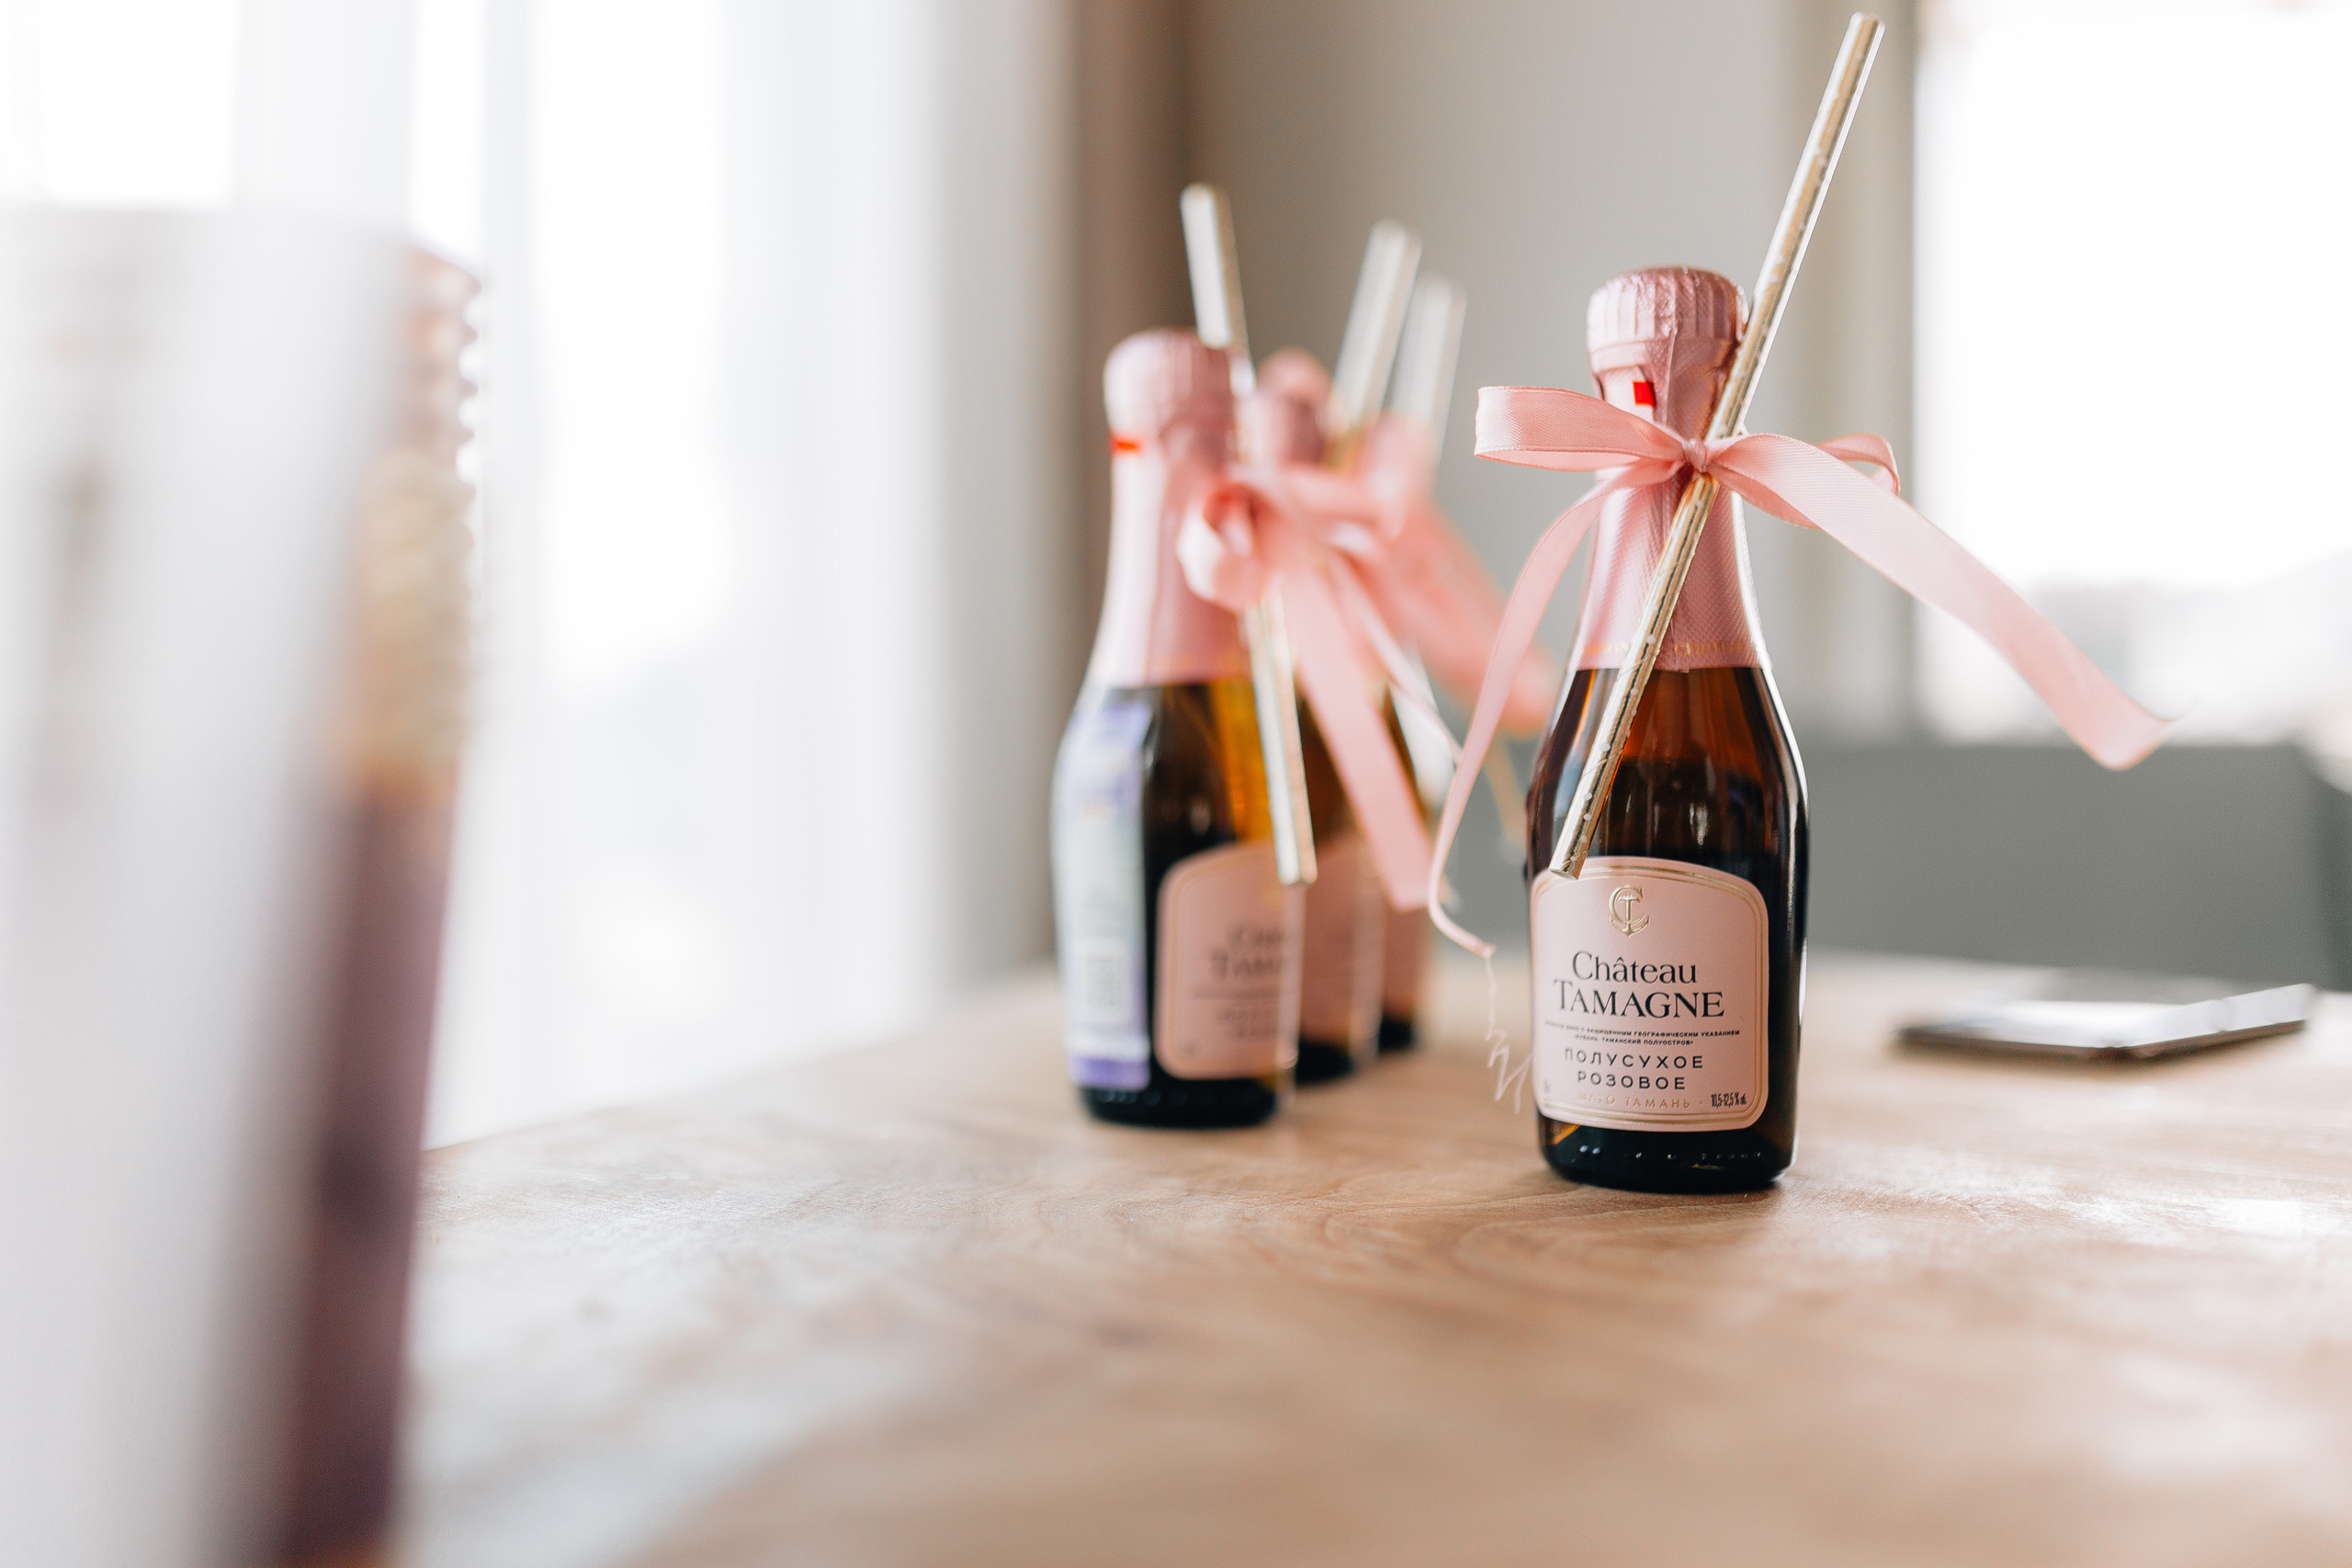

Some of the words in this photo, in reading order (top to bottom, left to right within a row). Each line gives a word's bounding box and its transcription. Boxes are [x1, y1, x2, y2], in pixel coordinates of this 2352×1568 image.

[1572, 951, 1697, 984] Château
[1554, 978, 1725, 1019] TAMAGNE
[1634, 1030, 1699, 1039] ГЕОГРАФИЧЕСКИМ
[1701, 1029, 1741, 1038] УКАЗАНИЕМ
[1564, 1047, 1703, 1069] ПОЛУСУХОЕ
[1577, 1070, 1686, 1090] РОЗОВОЕ
[1624, 1096, 1690, 1110] ТАМАНЬ
